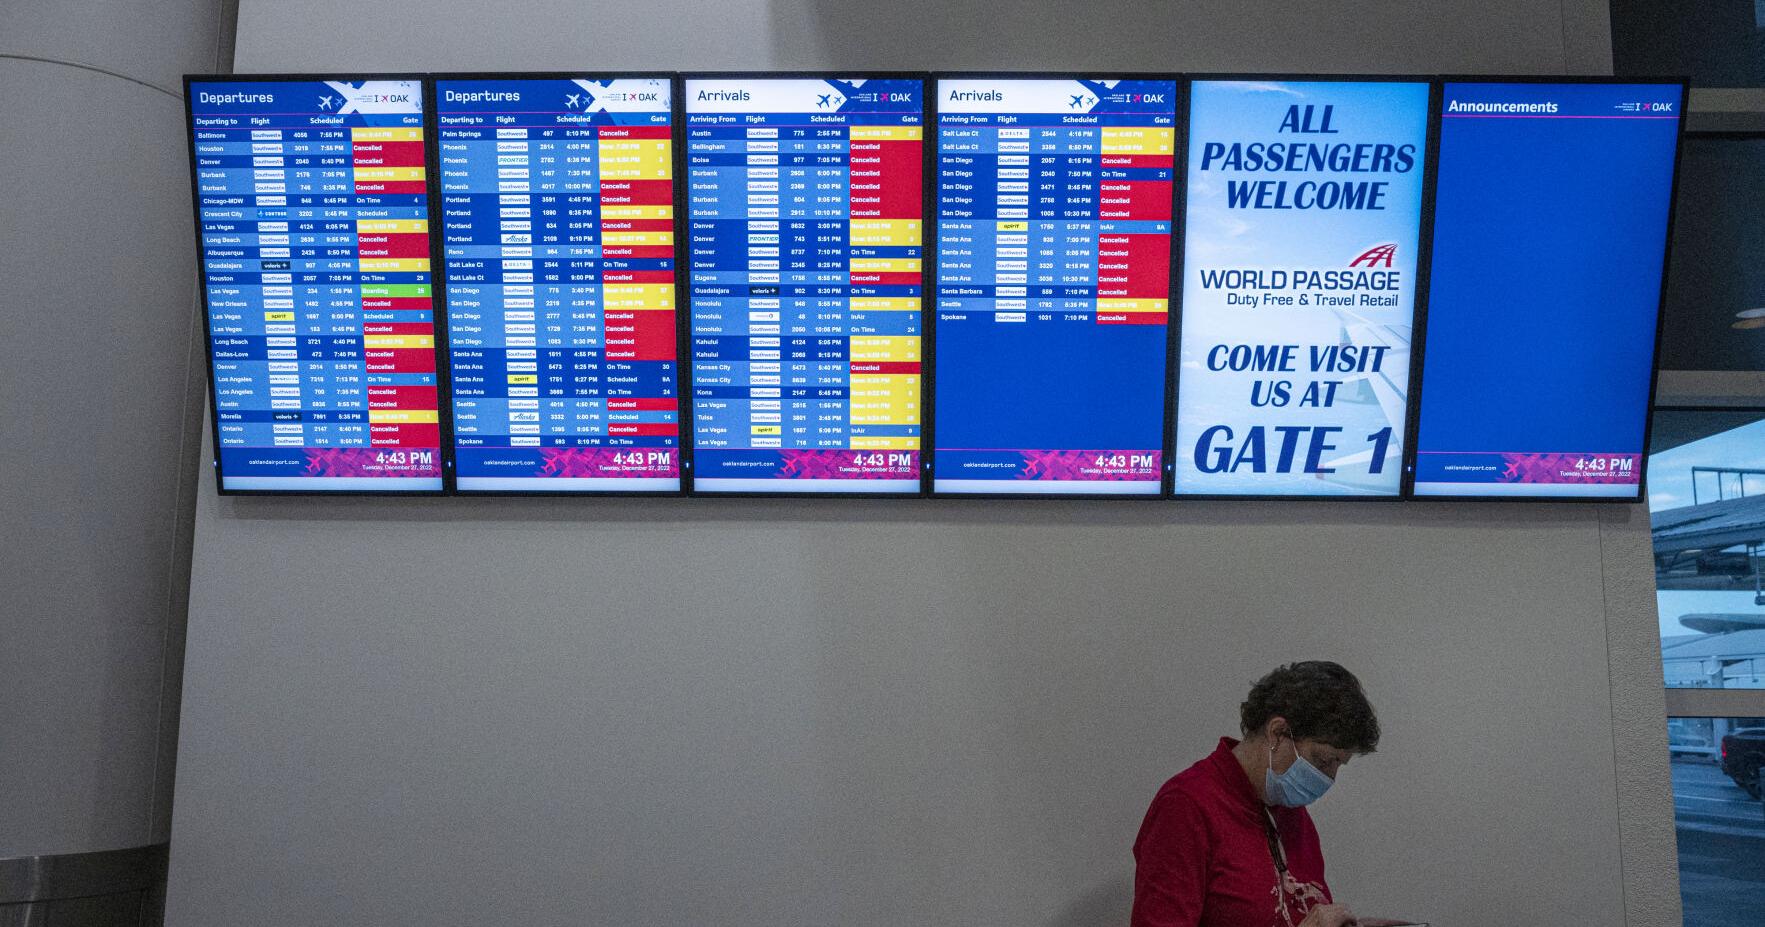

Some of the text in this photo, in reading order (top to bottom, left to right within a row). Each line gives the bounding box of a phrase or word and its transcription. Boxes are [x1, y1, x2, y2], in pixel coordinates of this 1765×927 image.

[200, 92, 273, 105] Departures
[446, 91, 520, 102] Departures
[698, 90, 750, 100] Arrivals
[873, 93, 877, 101] I
[950, 90, 1002, 100] Arrivals
[1126, 94, 1130, 102] I
[1144, 94, 1164, 102] OAK
[1449, 100, 1557, 112] Announcements
[1653, 103, 1672, 111] OAK
[942, 116, 968, 124] Arriving
[1279, 105, 1338, 133] ALL
[1201, 143, 1416, 173] PASSENGERS
[1228, 181, 1389, 210] WELCOME
[1200, 270, 1400, 290] WORLD PASSAGE
[1228, 293, 1398, 308] Duty Free & Travel Retail
[1208, 345, 1391, 372] COME VISIT
[1251, 381, 1343, 407] US AT
[1194, 426, 1392, 474] GATE 1
[376, 452, 432, 464] 4:43 PM
[614, 453, 670, 464] 4:43 PM
[854, 454, 910, 466] 4:43 PM
[1096, 456, 1152, 467] 4:43 PM
[1576, 459, 1632, 470] 4:43 PM
